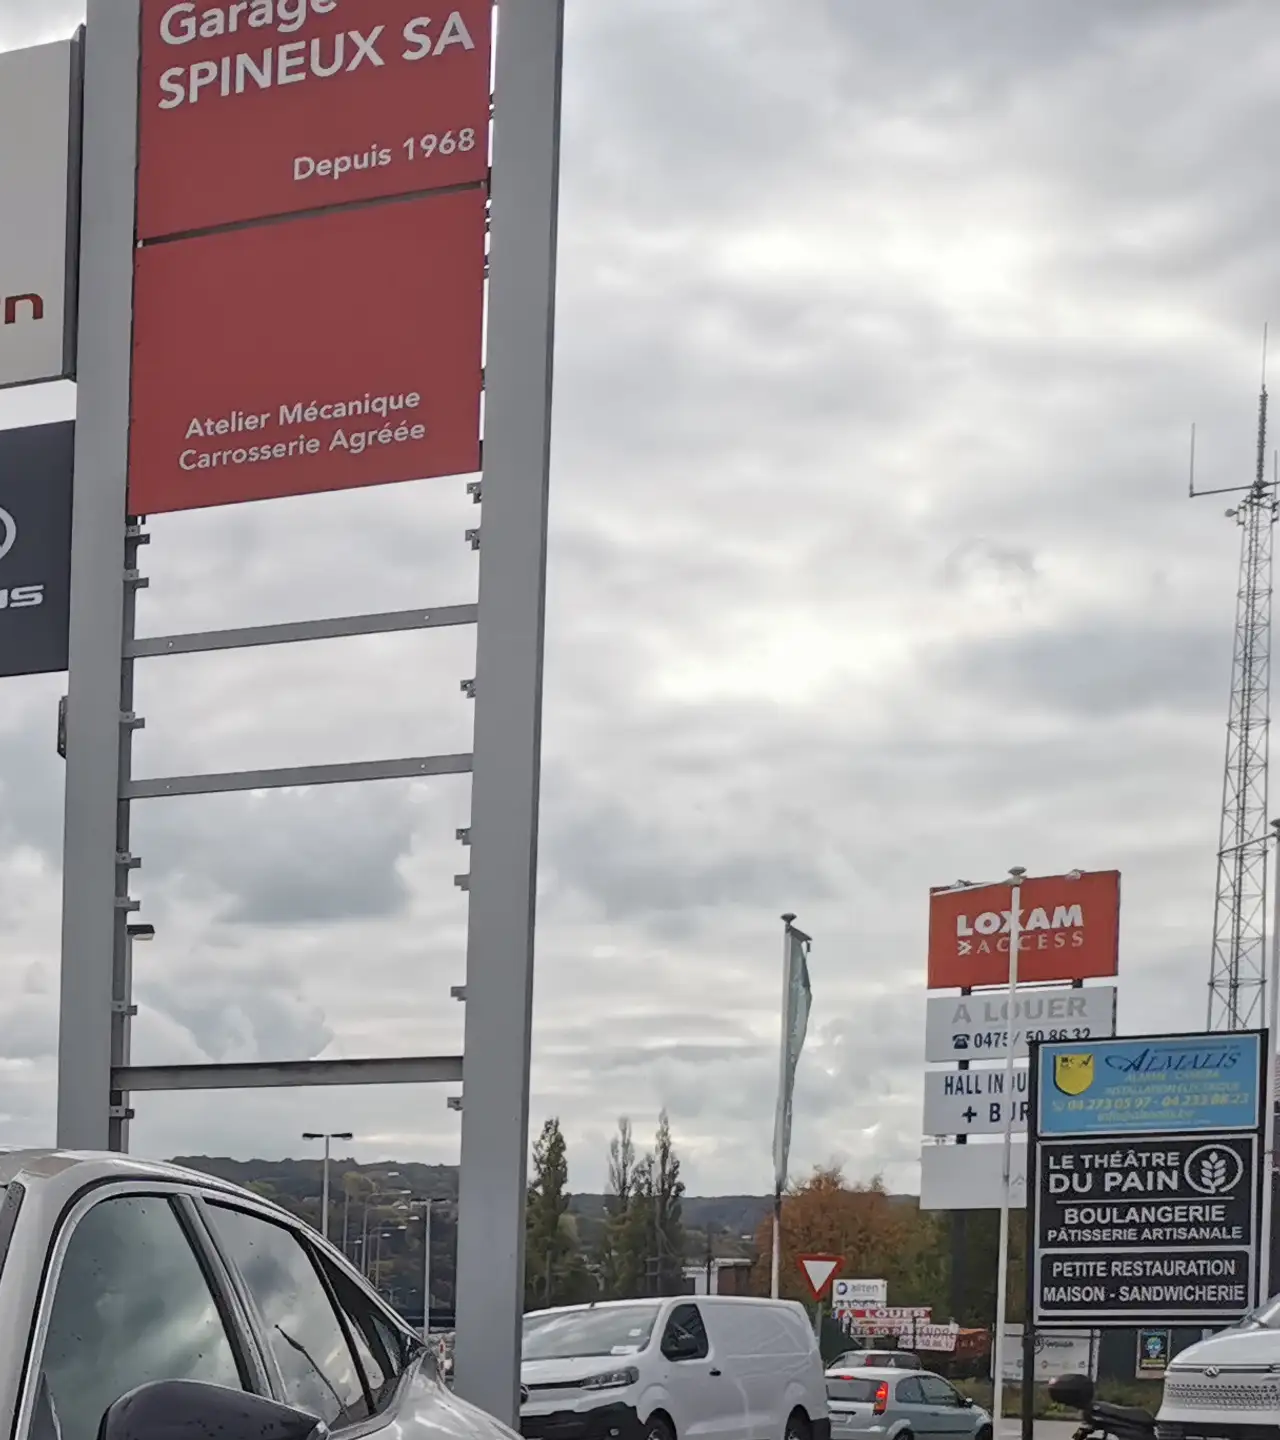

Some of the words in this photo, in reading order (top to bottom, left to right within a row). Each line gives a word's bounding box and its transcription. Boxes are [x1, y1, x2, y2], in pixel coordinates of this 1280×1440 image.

[159, 0, 337, 46] Garage
[158, 25, 386, 110] SPINEUX
[401, 11, 476, 61] SA
[293, 144, 392, 181] Depuis
[402, 127, 476, 161] 1968
[184, 411, 270, 439] Atelier
[278, 391, 421, 426] Mécanique
[178, 434, 321, 470] Carrosserie
[329, 419, 426, 454] Agréée
[956, 904, 1084, 937] LOXAM
[976, 931, 1084, 954] ACCESS
[952, 1003, 972, 1024] A
[984, 997, 1089, 1022] LOUER
[944, 1074, 982, 1096] HALL
[1048, 1155, 1074, 1170] LE
[1080, 1150, 1180, 1169] THÉÂTRE
[1048, 1172, 1093, 1194] DU
[1104, 1170, 1179, 1192] PAIN
[1064, 1205, 1226, 1225] BOULANGERIE
[1047, 1227, 1138, 1242] PÂTISSERIE
[1141, 1226, 1243, 1240] ARTISANALE
[1052, 1261, 1108, 1277] PETITE
[1111, 1259, 1236, 1277] RESTAURATION
[1043, 1286, 1105, 1302] MAISON
[1119, 1284, 1246, 1302] SANDWICHERIE
[865, 1308, 927, 1319] LOUER
